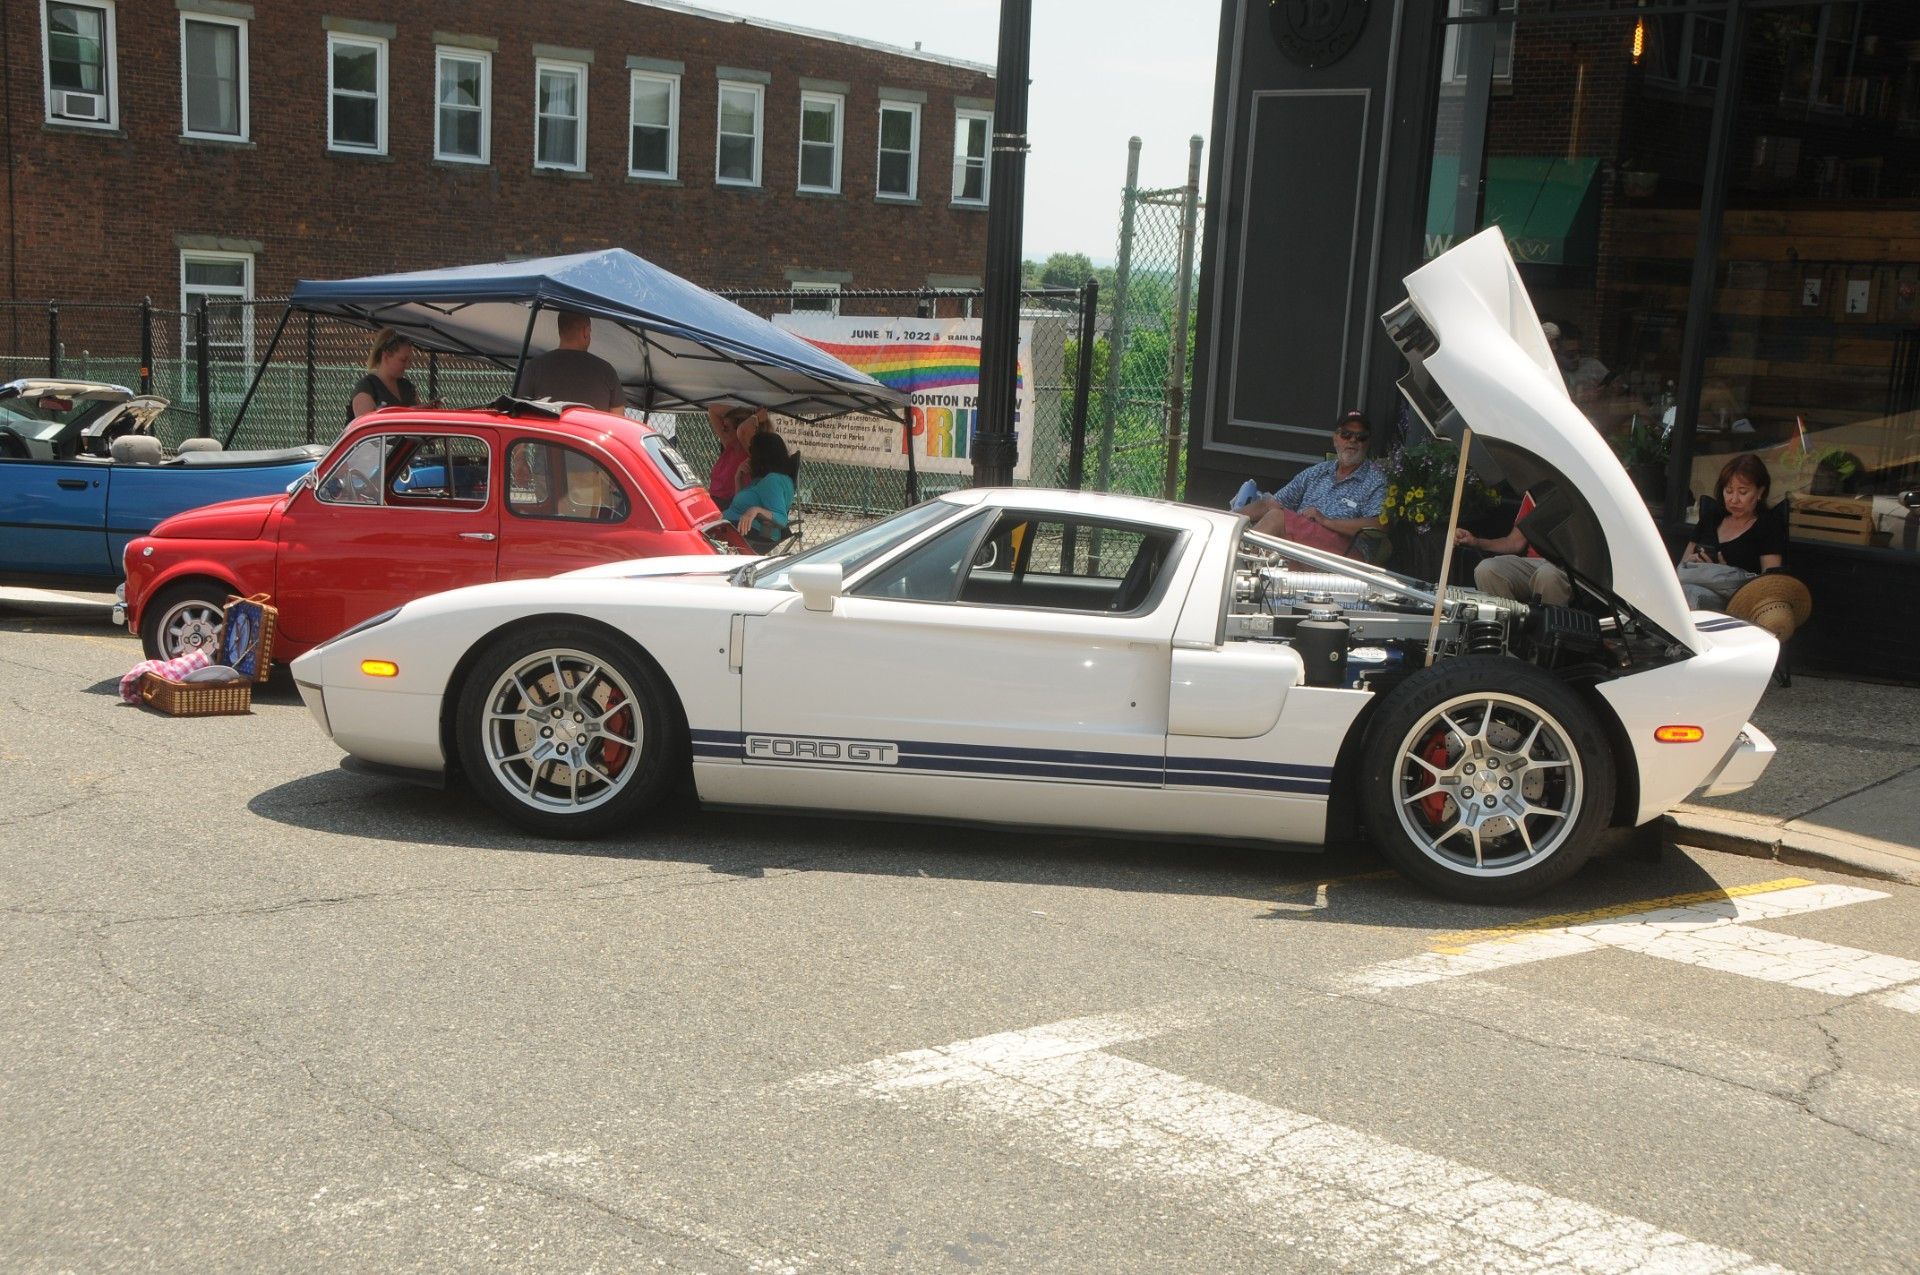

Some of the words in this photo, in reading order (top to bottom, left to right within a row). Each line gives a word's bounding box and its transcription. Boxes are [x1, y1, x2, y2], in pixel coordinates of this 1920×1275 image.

[851, 330, 879, 339] JUNE
[903, 330, 931, 341] 2022
[911, 393, 959, 407] OONTON
[750, 738, 841, 760] FORD
[847, 743, 894, 762] GT
